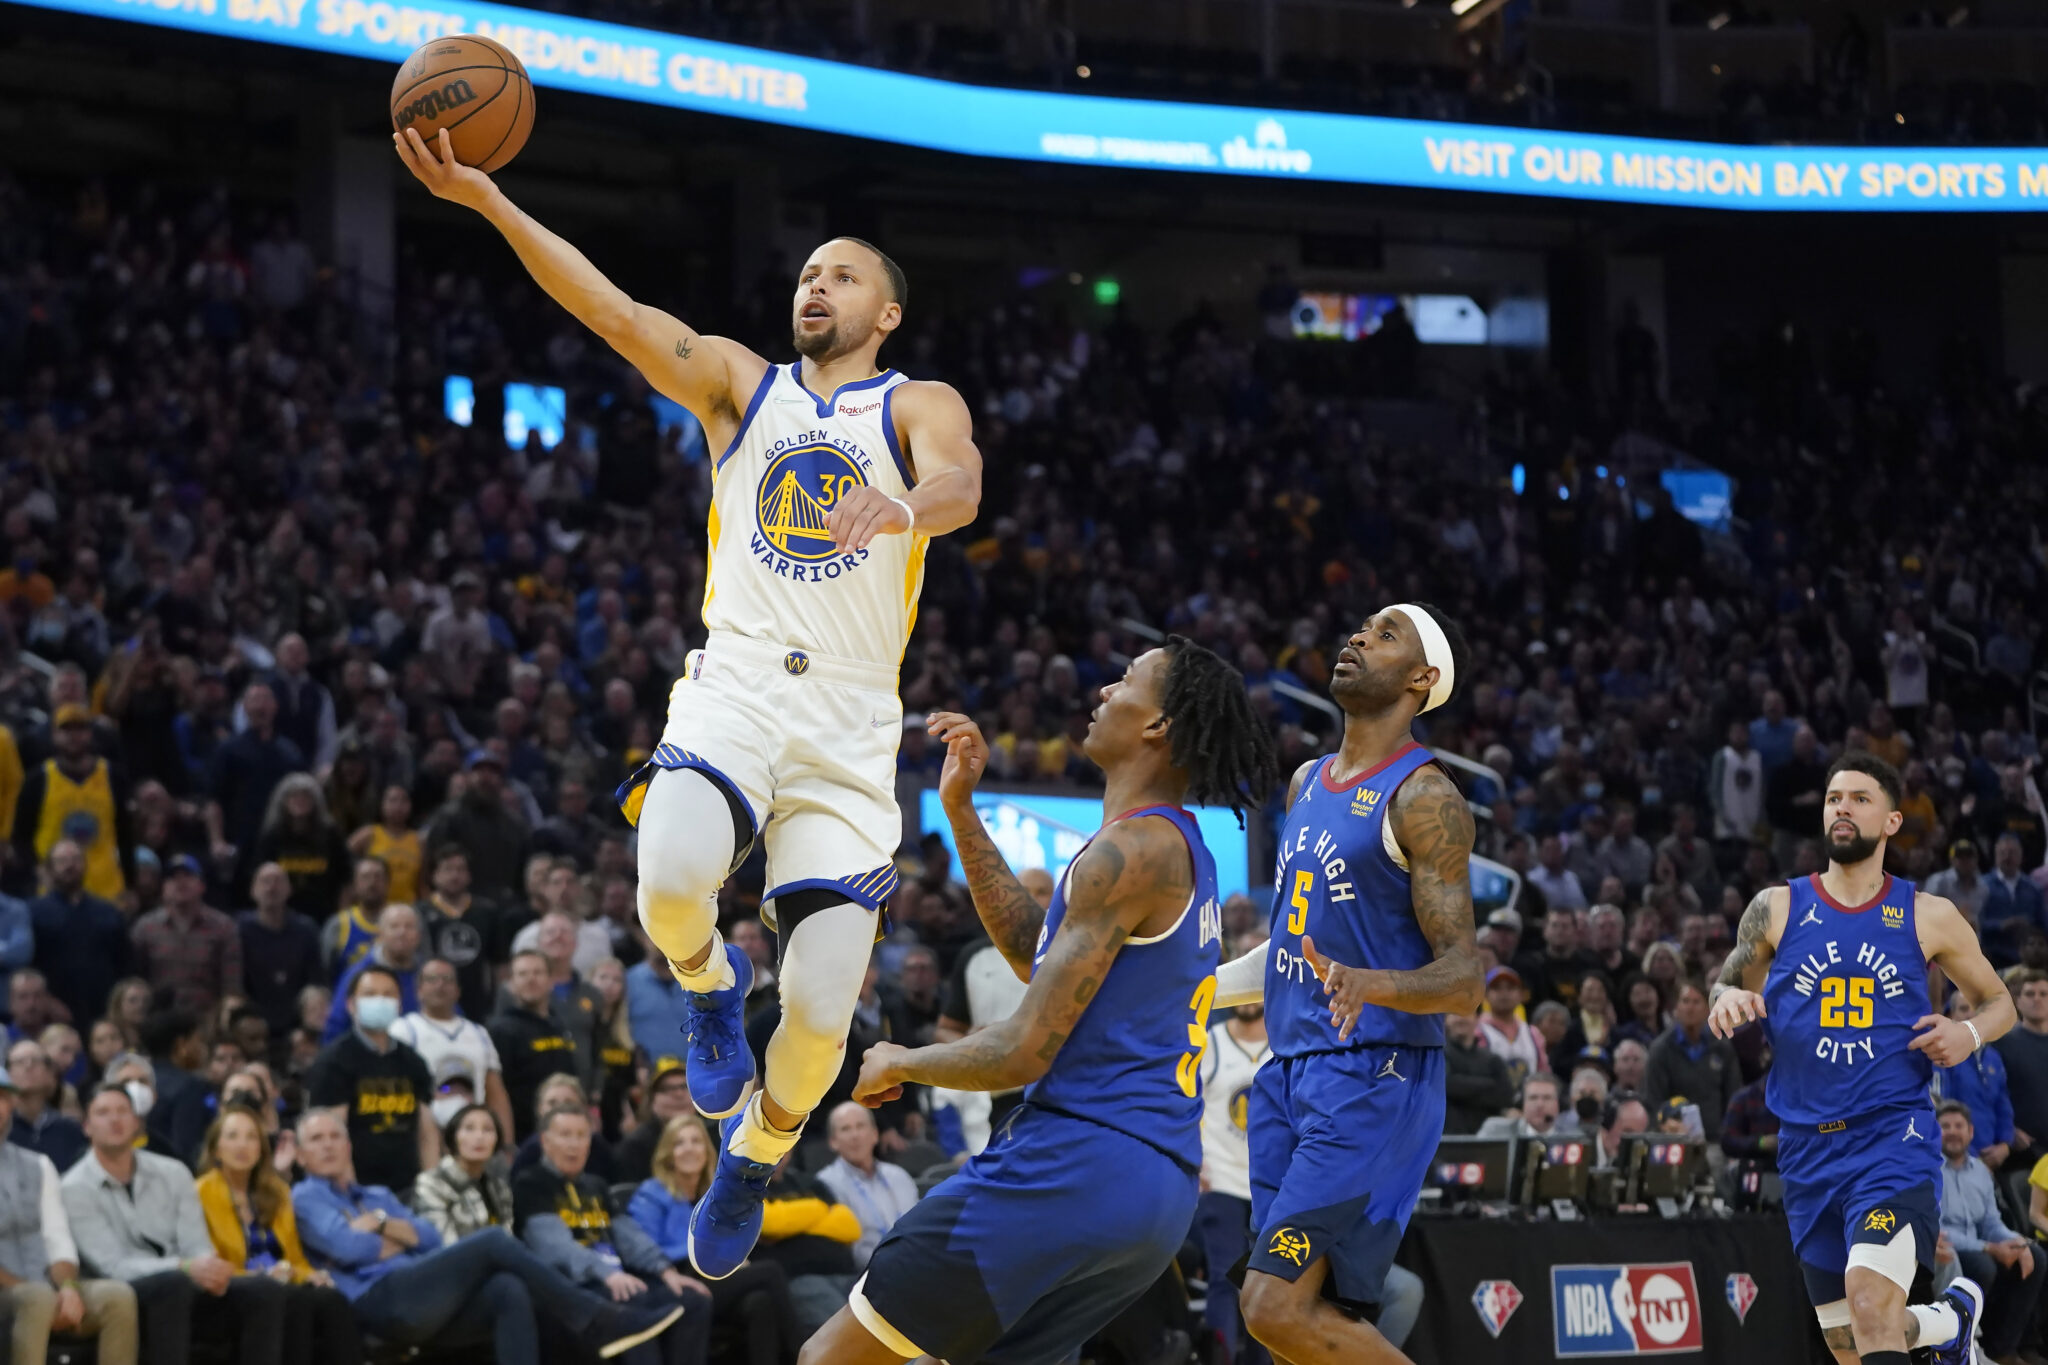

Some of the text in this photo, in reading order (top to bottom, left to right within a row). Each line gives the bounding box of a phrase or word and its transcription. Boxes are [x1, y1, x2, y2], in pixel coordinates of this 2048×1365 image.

[395, 78, 478, 130] Wilson
[667, 53, 808, 111] CENTER
[1423, 136, 1516, 179] VISIT
[1523, 145, 1604, 186] OUR
[1611, 152, 1763, 196] MISSION
[1774, 161, 1849, 197] BAY
[1859, 162, 2006, 198] SPORTS
[838, 402, 881, 415] Rakuten
[765, 429, 873, 471] GOLDEN STATE
[750, 531, 869, 582] WARRIORS
[787, 655, 809, 673] W
[1351, 801, 1374, 813] Western
[1356, 786, 1382, 805] WU
[1275, 826, 1356, 903] MILE HIGH
[1287, 869, 1314, 936] 5
[1882, 904, 1904, 919] WU
[1276, 947, 1318, 984] CIT
[1794, 940, 1905, 999] MILE HIGH
[1820, 976, 1875, 1029] 25
[1175, 974, 1218, 1098] 3
[1816, 1036, 1875, 1065] CITY
[1563, 1283, 1690, 1337] NBA TNT
